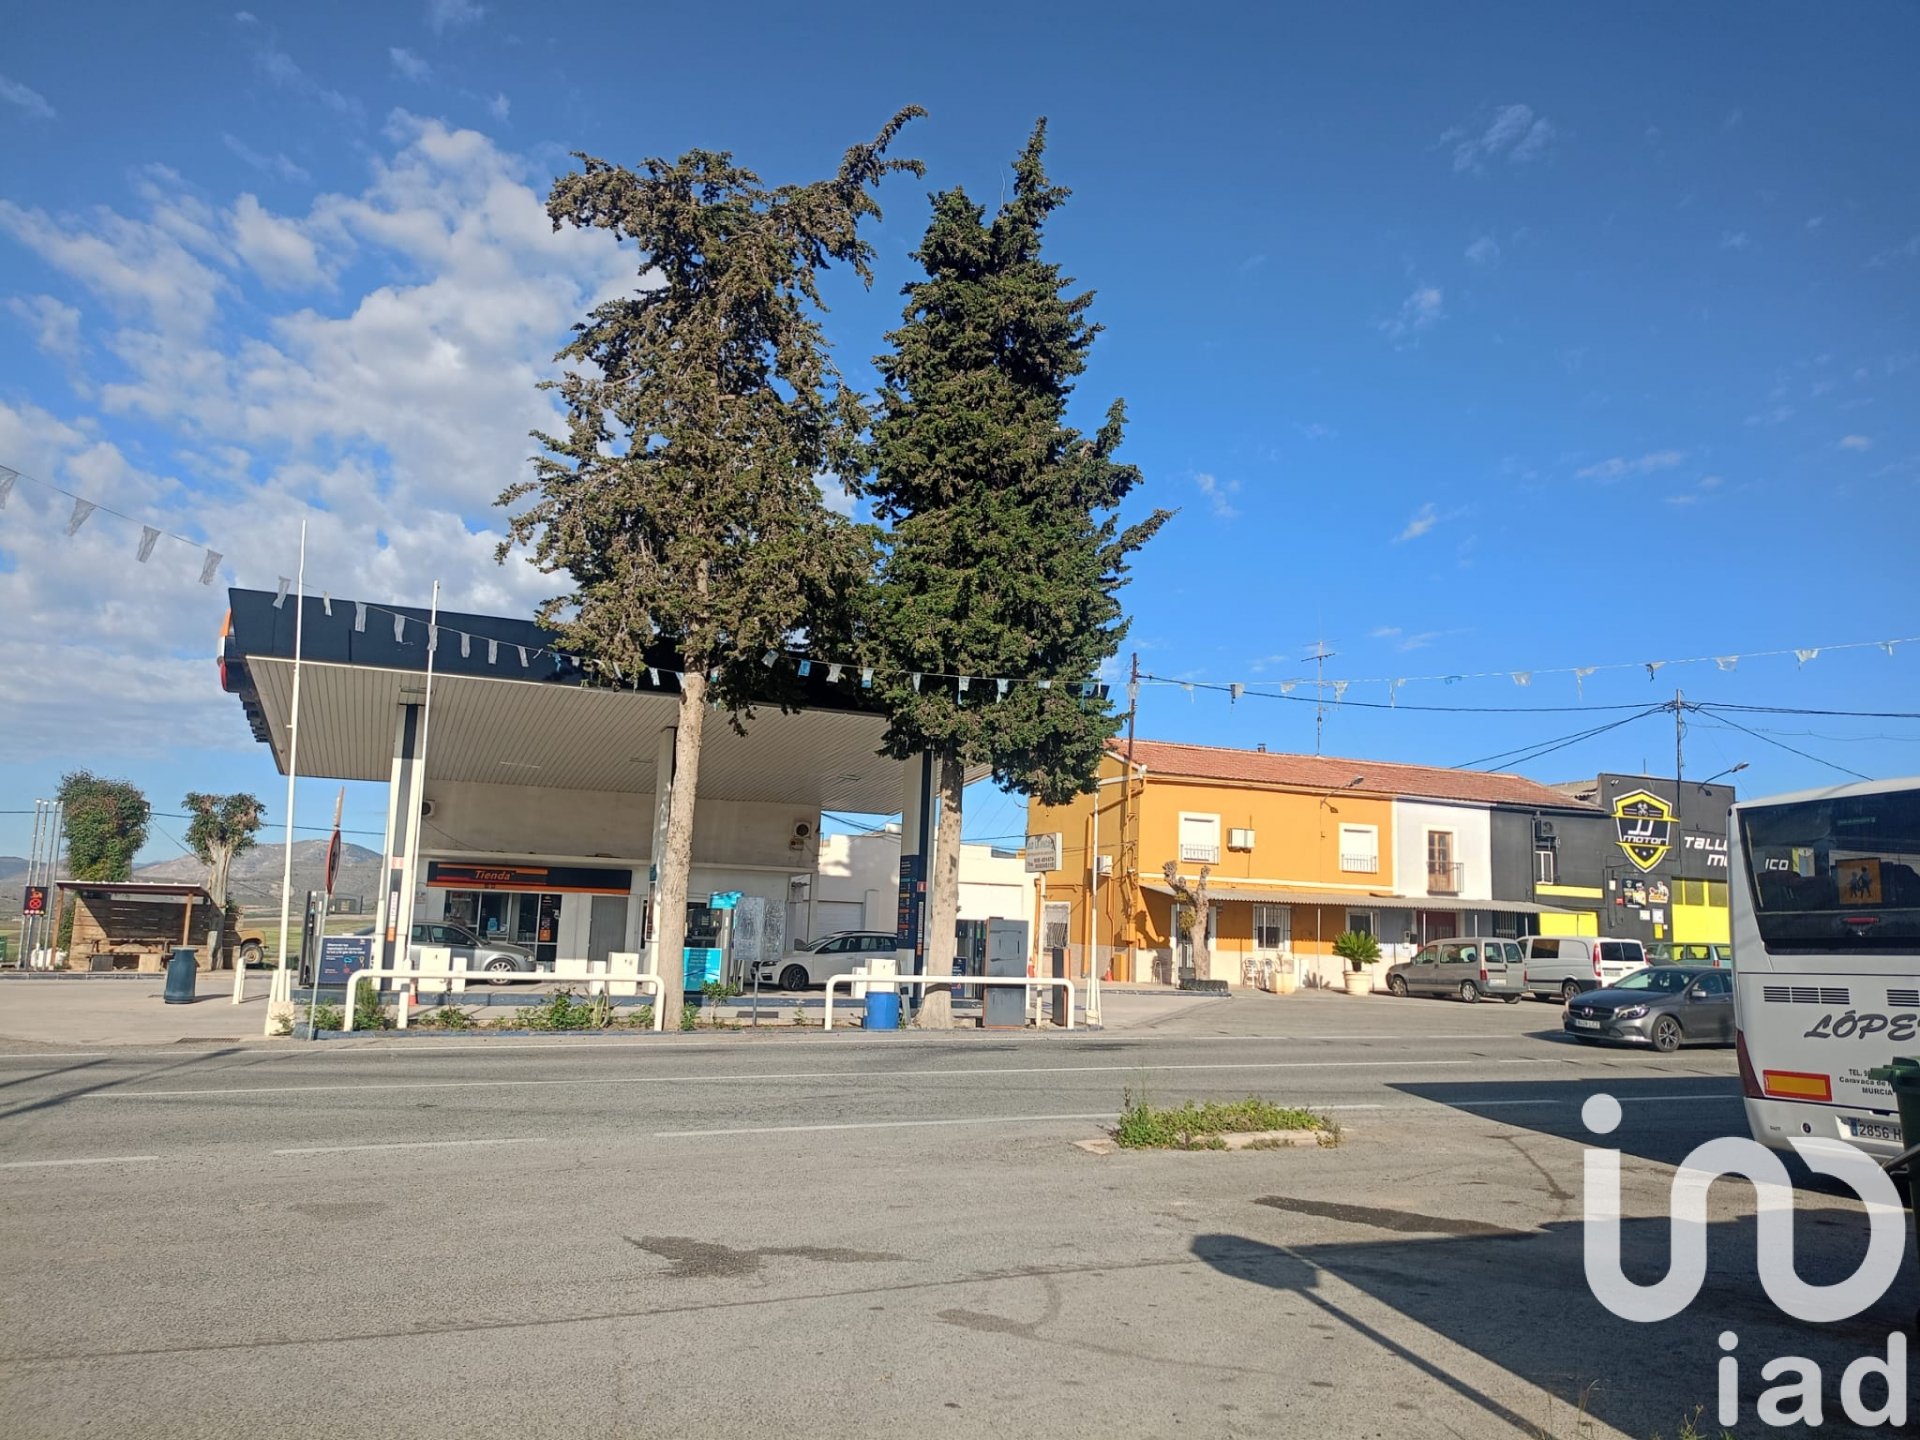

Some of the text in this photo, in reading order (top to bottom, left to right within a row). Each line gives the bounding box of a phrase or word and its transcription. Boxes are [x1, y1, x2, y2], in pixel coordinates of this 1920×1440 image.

[474, 869, 511, 881] Tienda
[1803, 1009, 1920, 1041] LÓPE
[1848, 1068, 1863, 1077] TEL.
[1839, 1076, 1875, 1086] Caravaca
[1862, 1087, 1893, 1096] MURCIA
[1859, 1124, 1890, 1139] 2856
